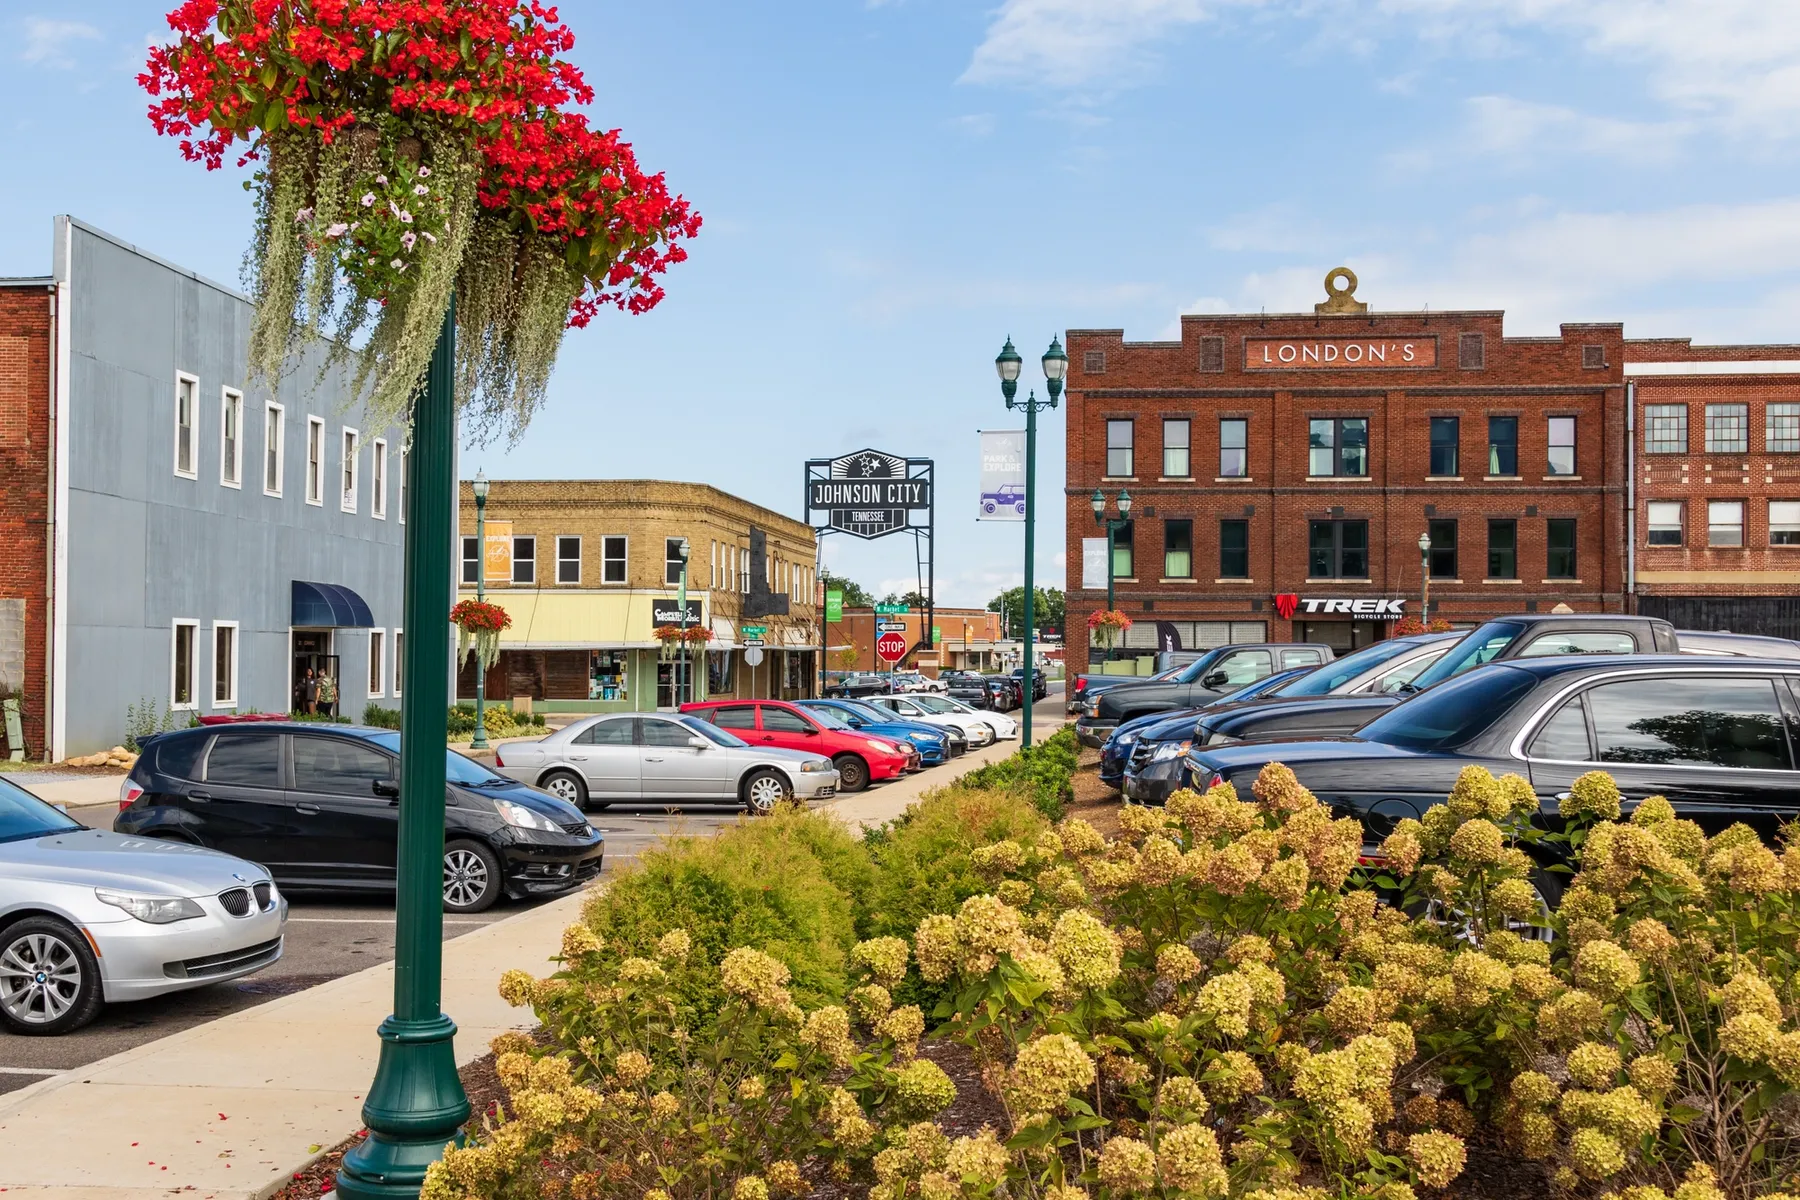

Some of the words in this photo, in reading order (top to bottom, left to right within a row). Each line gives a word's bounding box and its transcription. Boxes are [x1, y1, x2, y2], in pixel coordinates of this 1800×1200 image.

[1264, 343, 1415, 362] LONDON'S
[984, 463, 1021, 471] EXPLORE
[815, 484, 881, 504] JOHNSON
[887, 484, 921, 503] CITY
[852, 511, 884, 522] TENNESSEE
[1301, 599, 1407, 613] TREK
[879, 641, 905, 653] STOP
